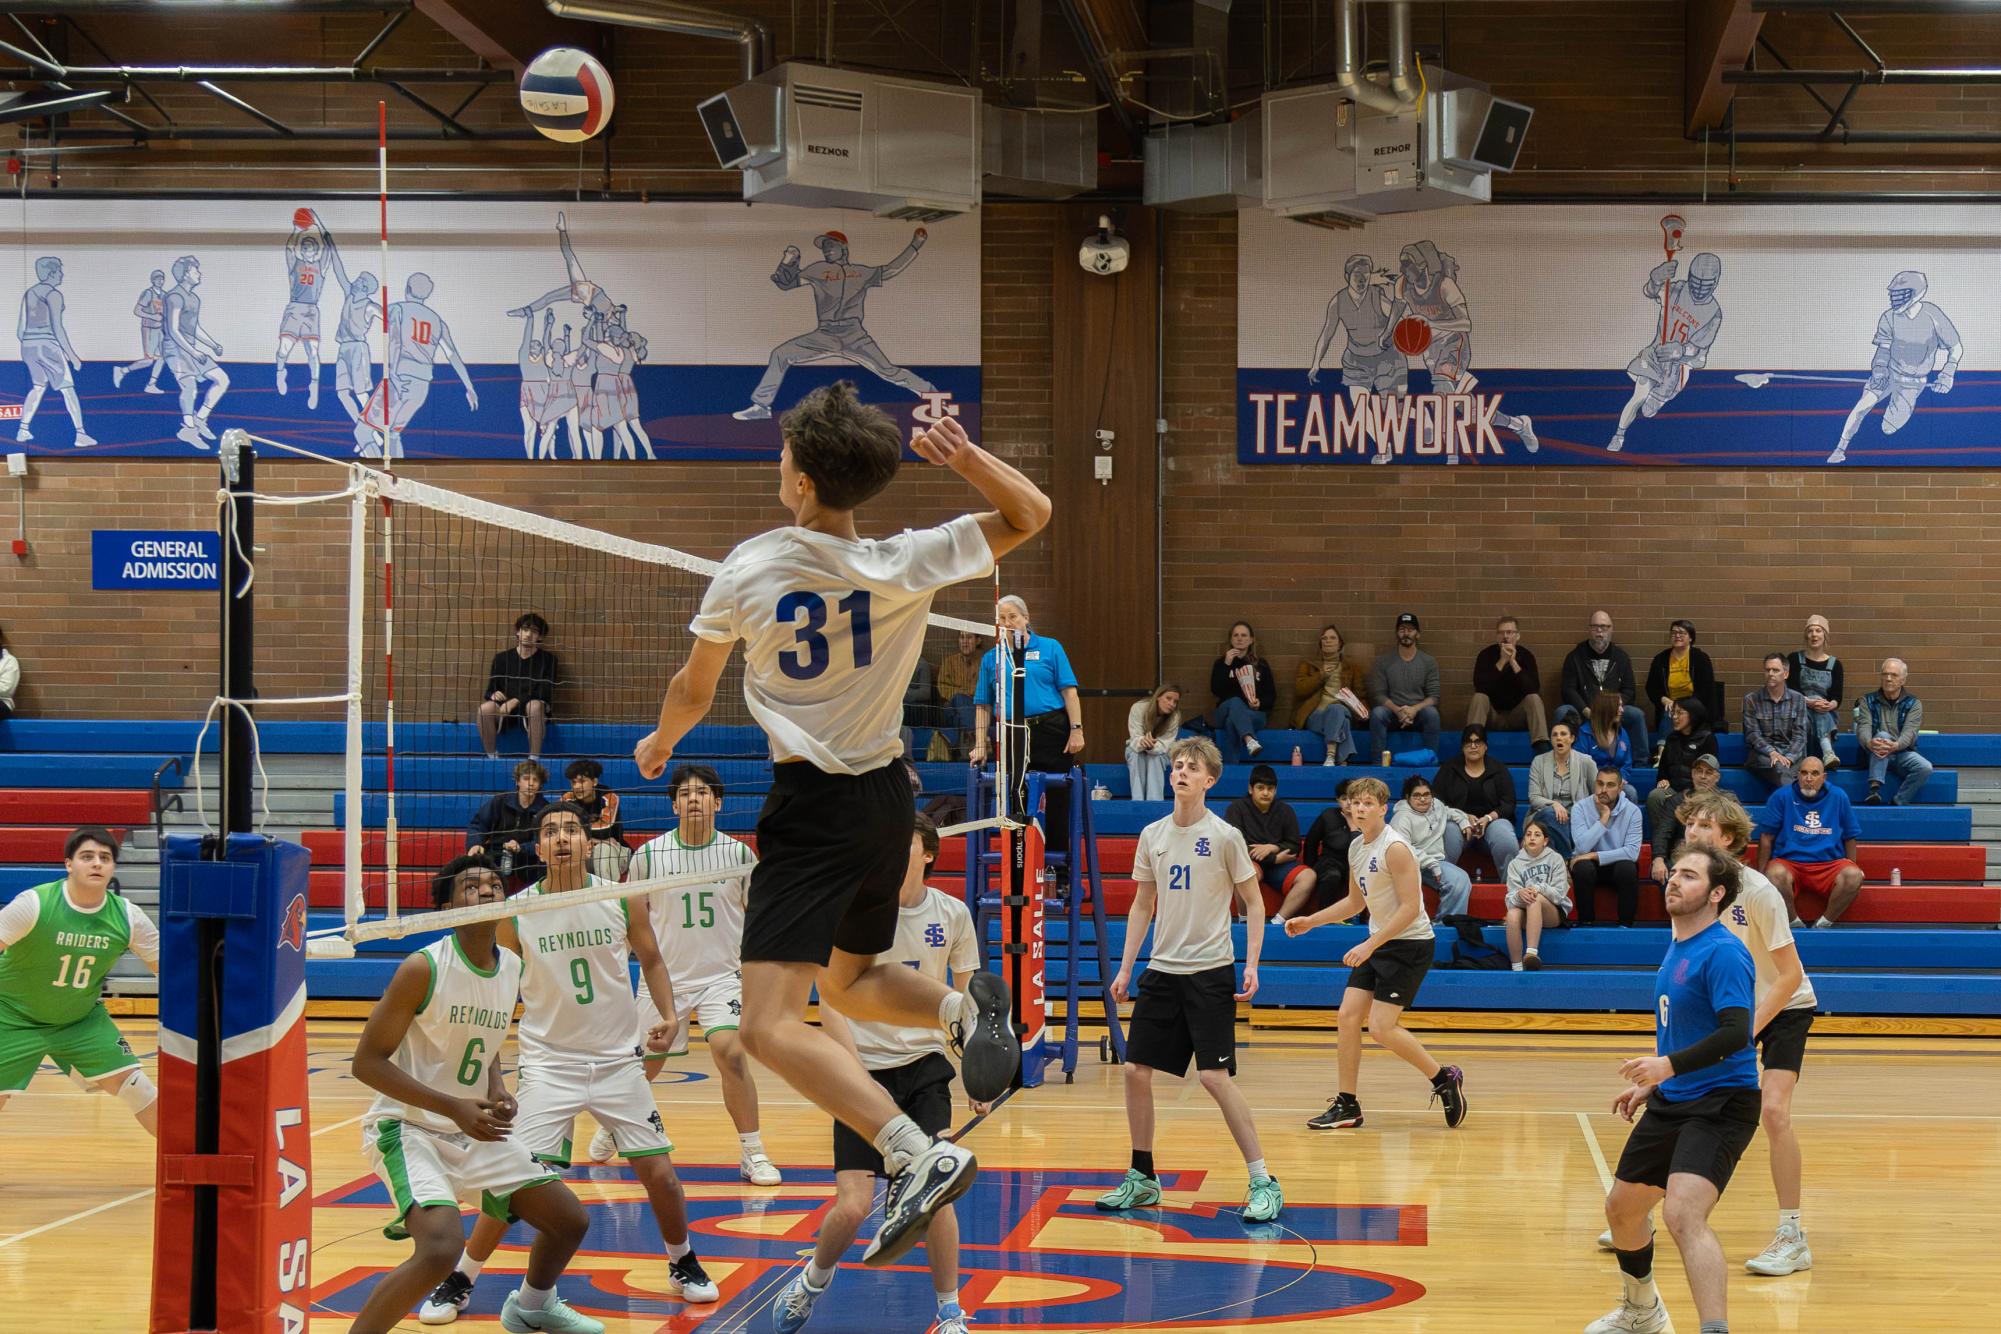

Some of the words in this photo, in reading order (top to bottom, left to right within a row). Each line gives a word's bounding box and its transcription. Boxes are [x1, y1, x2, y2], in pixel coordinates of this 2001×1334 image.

[808, 145, 849, 157] REZNOR
[1374, 144, 1411, 156] REZNOR
[299, 274, 314, 286] 20
[410, 316, 432, 345] 10
[1670, 319, 1690, 343] 15
[1249, 393, 1505, 455] TEAMWORK
[130, 541, 208, 558] GENERAL
[122, 562, 217, 579] ADMISSION
[776, 589, 873, 681] 31
[1169, 865, 1191, 890] 21
[681, 891, 716, 929] 15
[1032, 868, 1045, 959] SALLE
[56, 931, 110, 950] RAIDERS
[538, 928, 613, 954] REYNOLDS
[52, 954, 97, 989] 16
[569, 957, 595, 1006] 9
[1032, 970, 1045, 1005] LA
[1659, 994, 1670, 1028] 6
[457, 1037, 486, 1087] 6
[275, 1107, 308, 1210] LA
